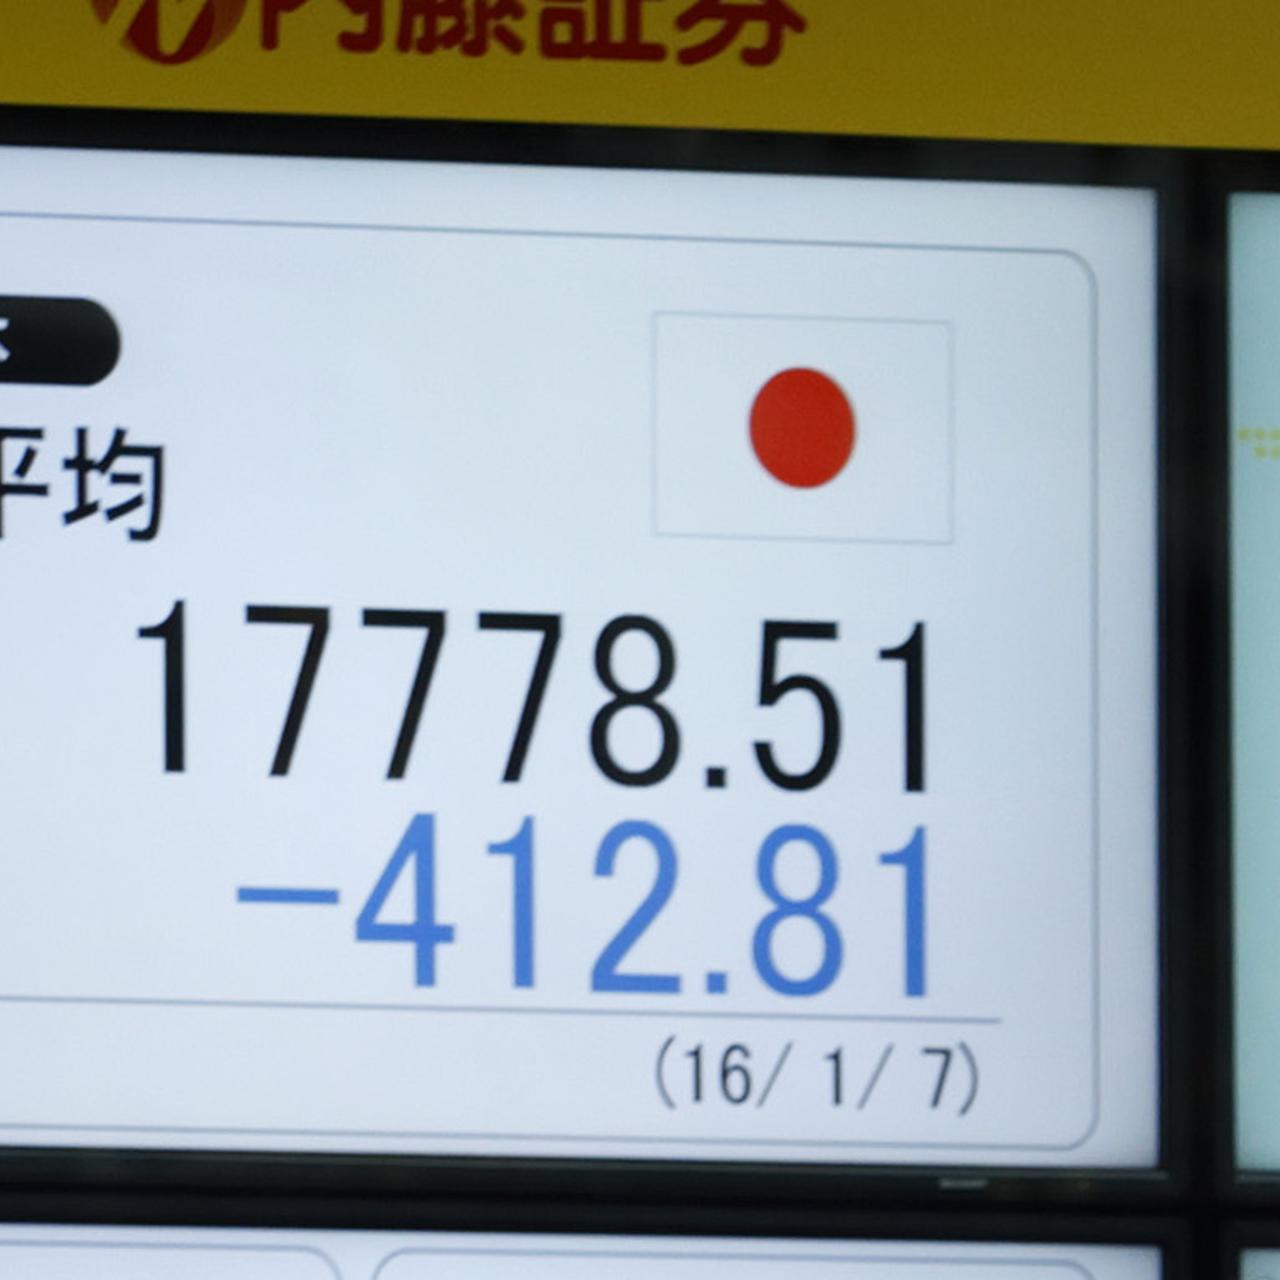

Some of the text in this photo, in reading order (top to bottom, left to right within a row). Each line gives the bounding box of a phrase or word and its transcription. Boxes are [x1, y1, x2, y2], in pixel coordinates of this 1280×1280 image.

[137, 599, 926, 794] 17778.51
[237, 812, 926, 999] -412.81
[656, 1036, 979, 1116] (16/ 1/ 7)
